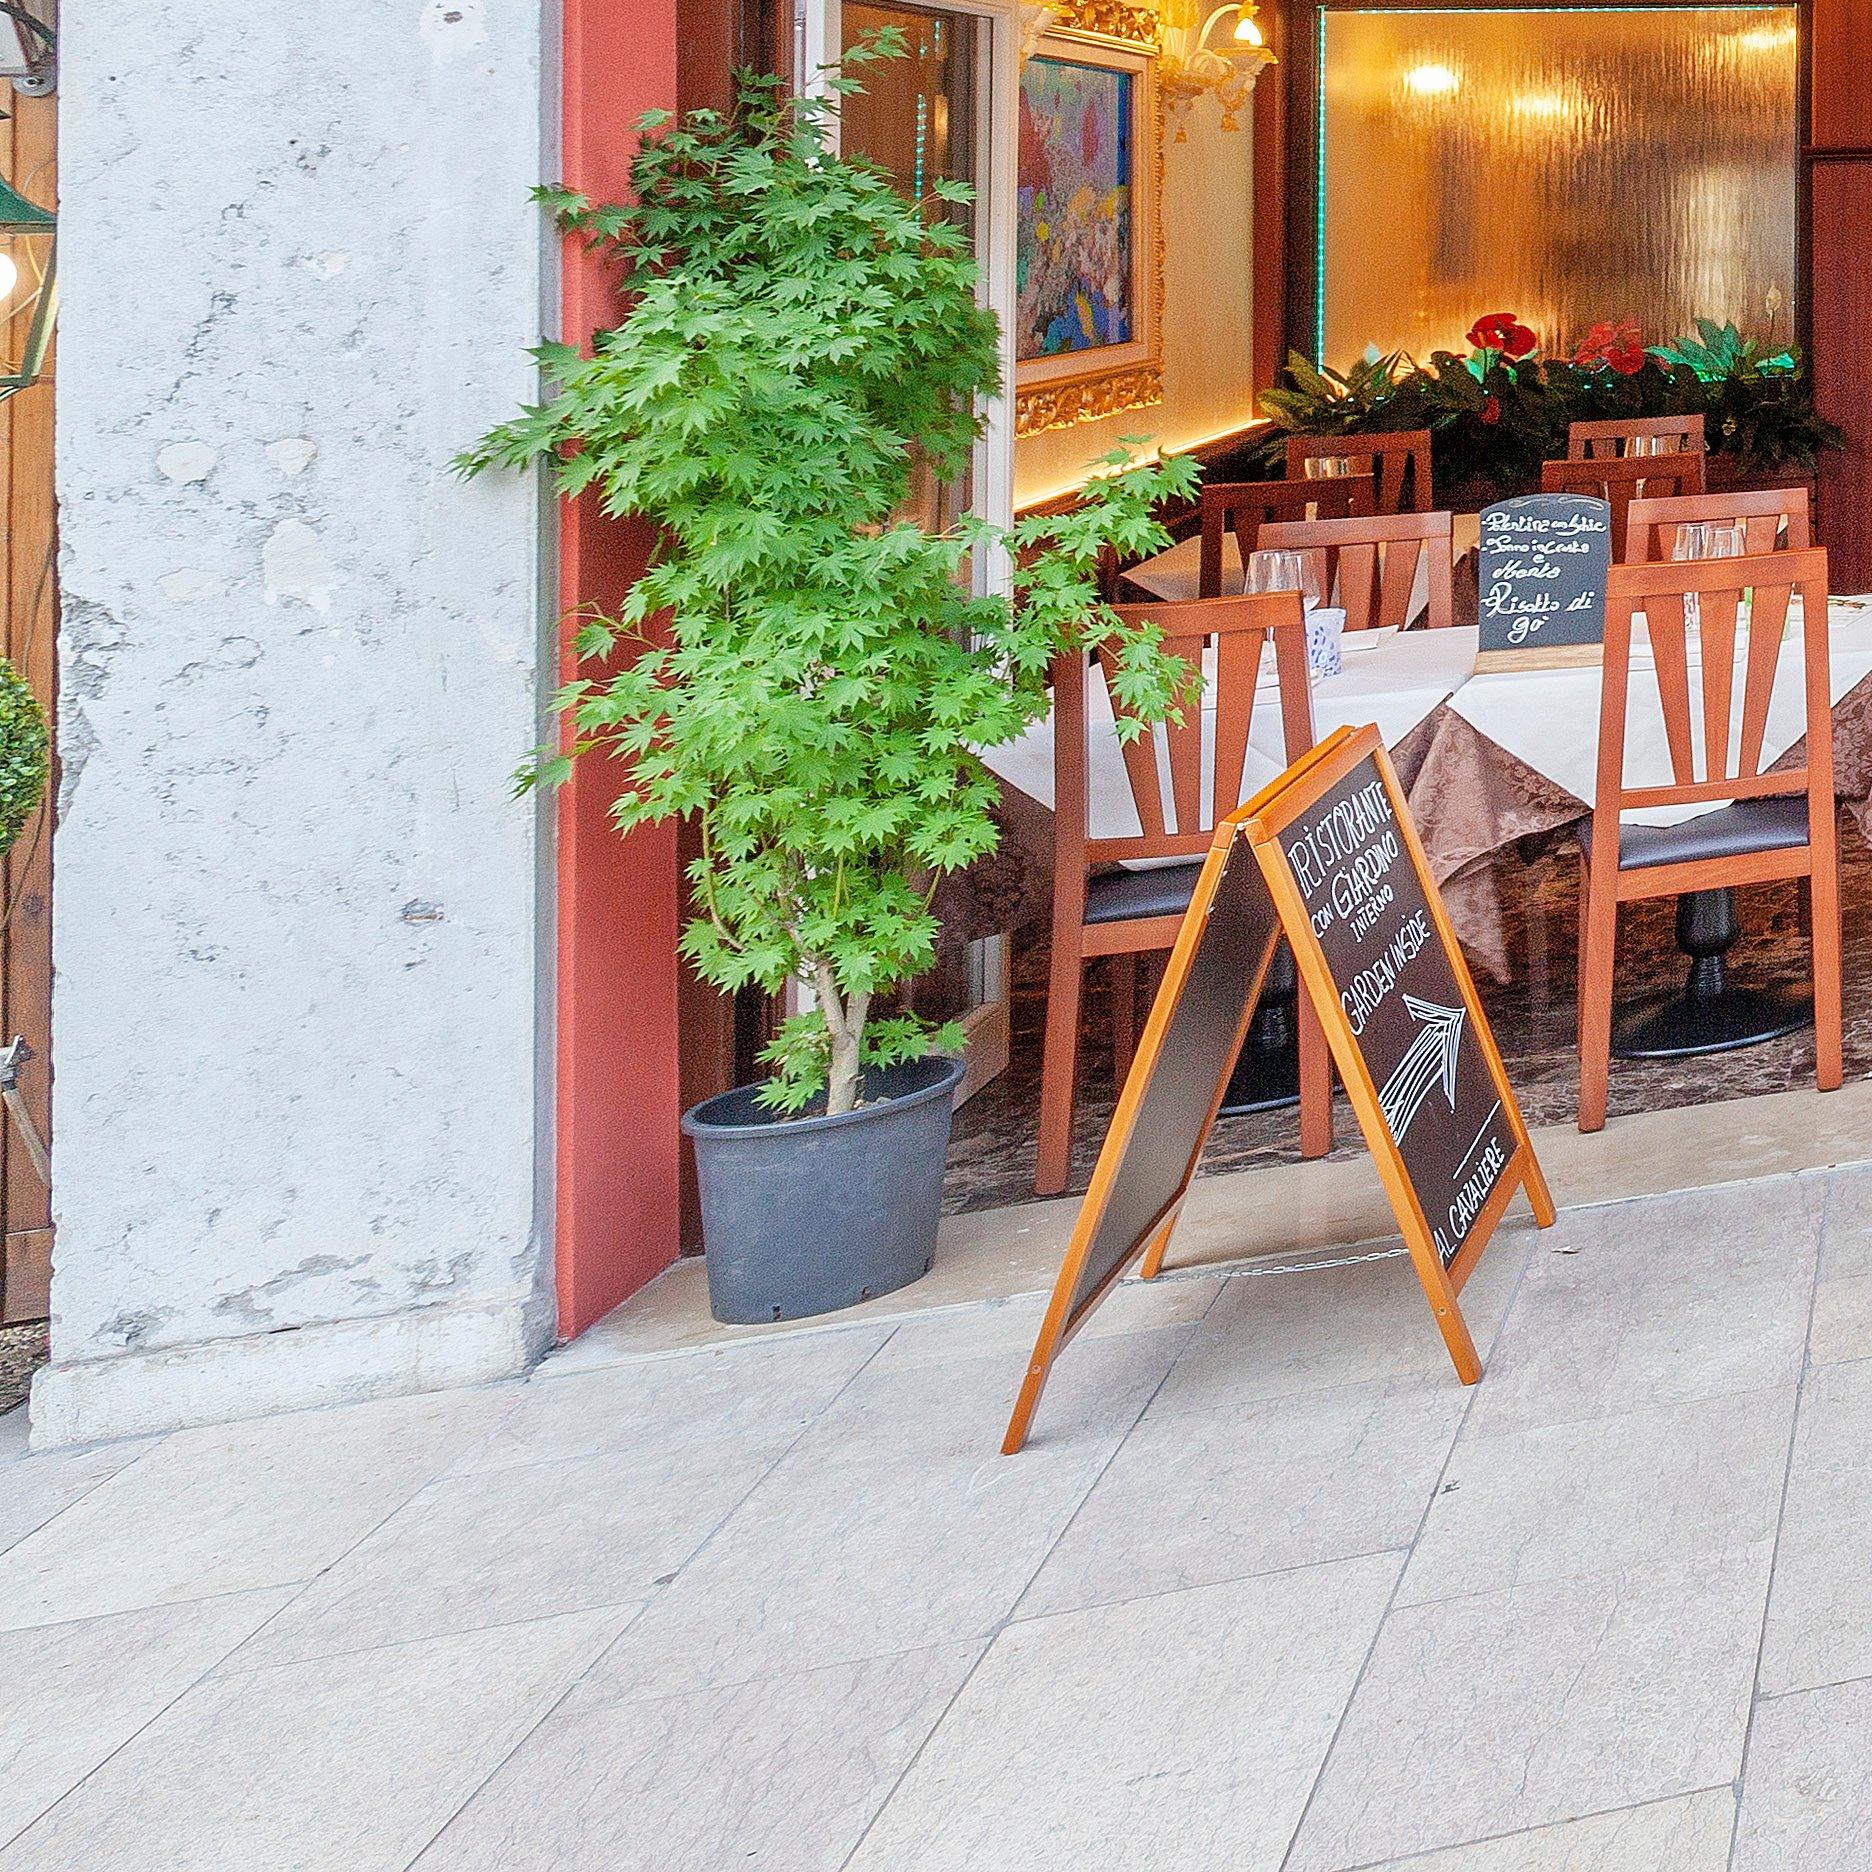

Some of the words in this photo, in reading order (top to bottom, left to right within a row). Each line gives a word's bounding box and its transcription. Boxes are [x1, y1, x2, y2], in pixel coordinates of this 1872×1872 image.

[1563, 591, 1596, 612] di
[1287, 780, 1393, 900] RISTORANTE
[1331, 830, 1399, 920] GIARDINO
[1349, 884, 1394, 943] INTERNO
[1341, 951, 1396, 1036] GARDEN
[1389, 909, 1431, 973] INSIDE
[1433, 1227, 1458, 1266] AL
[1448, 1136, 1506, 1240] CAVALIERE
